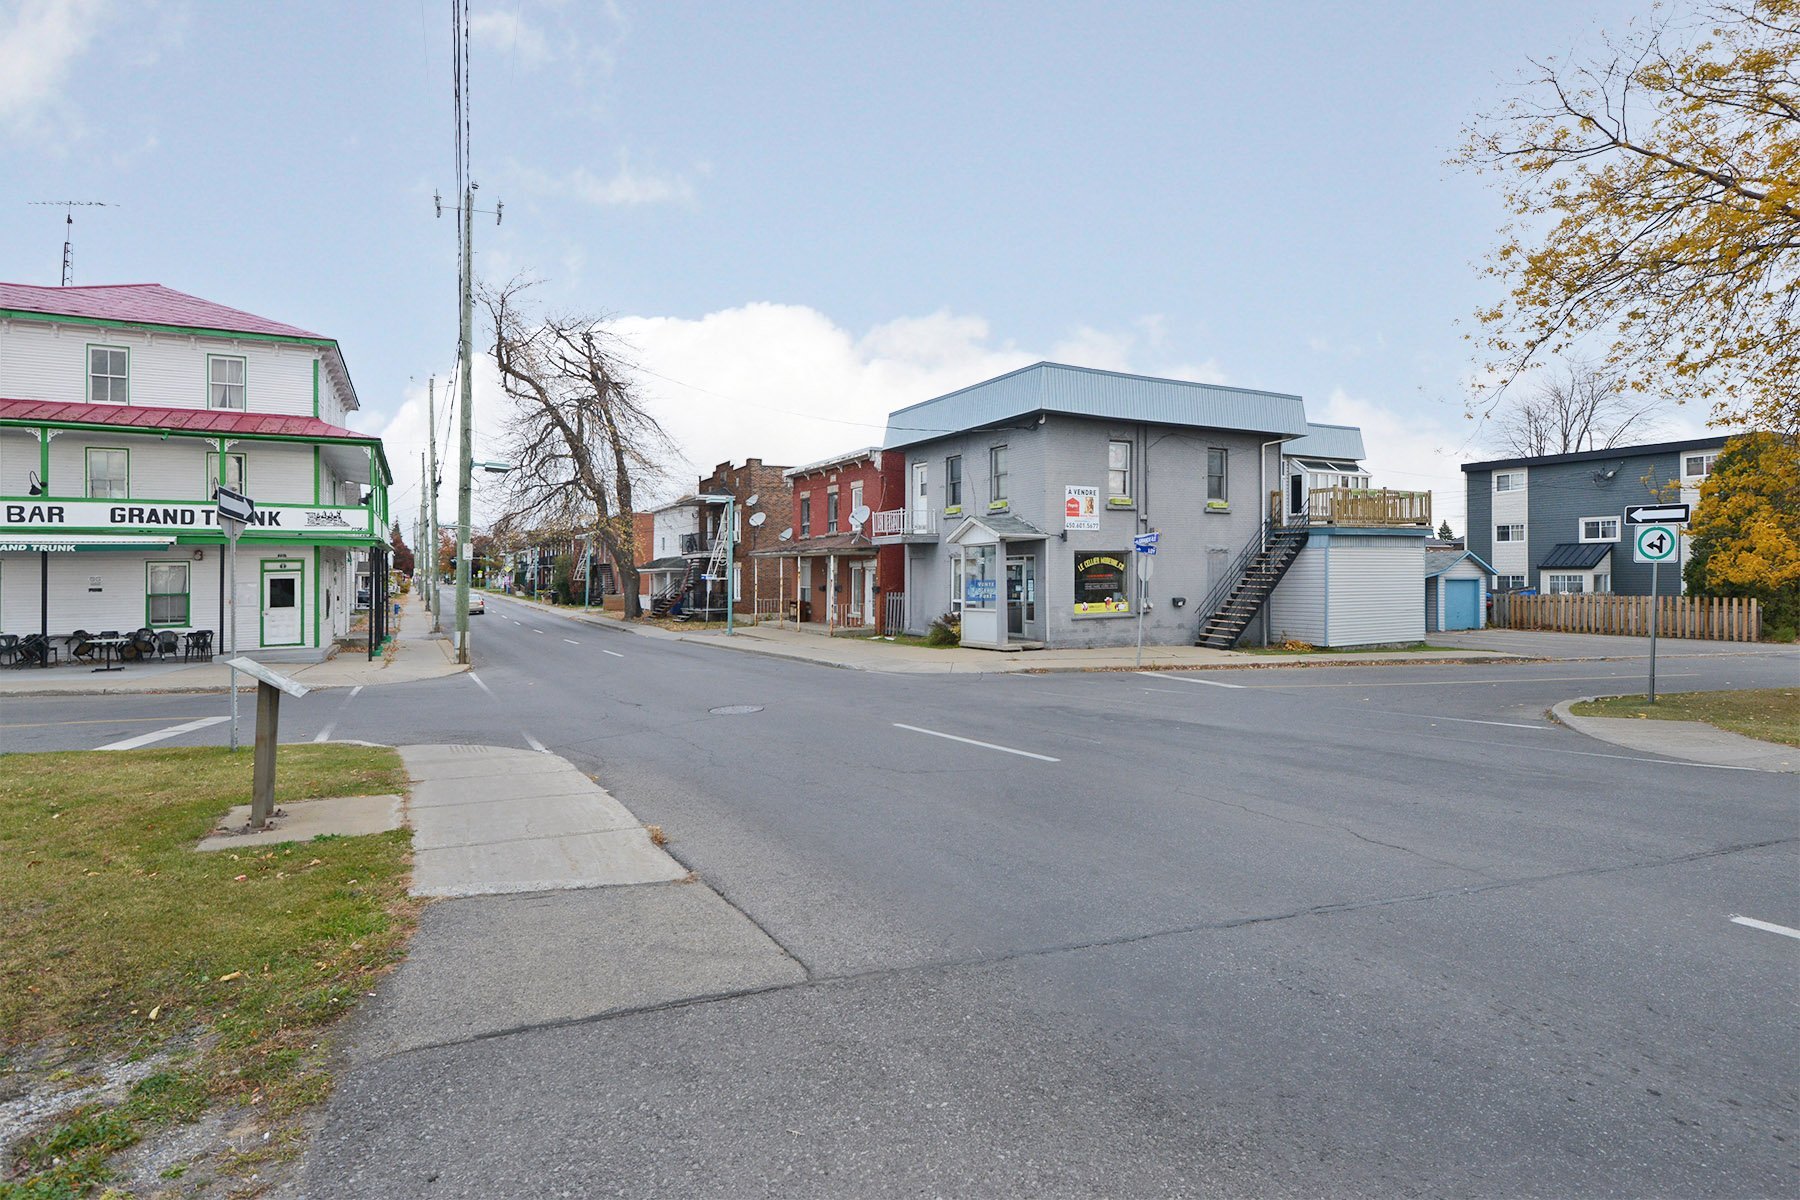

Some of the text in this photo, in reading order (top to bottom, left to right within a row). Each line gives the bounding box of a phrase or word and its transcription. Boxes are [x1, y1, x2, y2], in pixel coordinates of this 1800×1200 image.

[6, 505, 65, 523] BAR
[110, 507, 282, 526] GRAND TNK
[31, 544, 76, 552] TRUNK
[1077, 563, 1085, 572] LE
